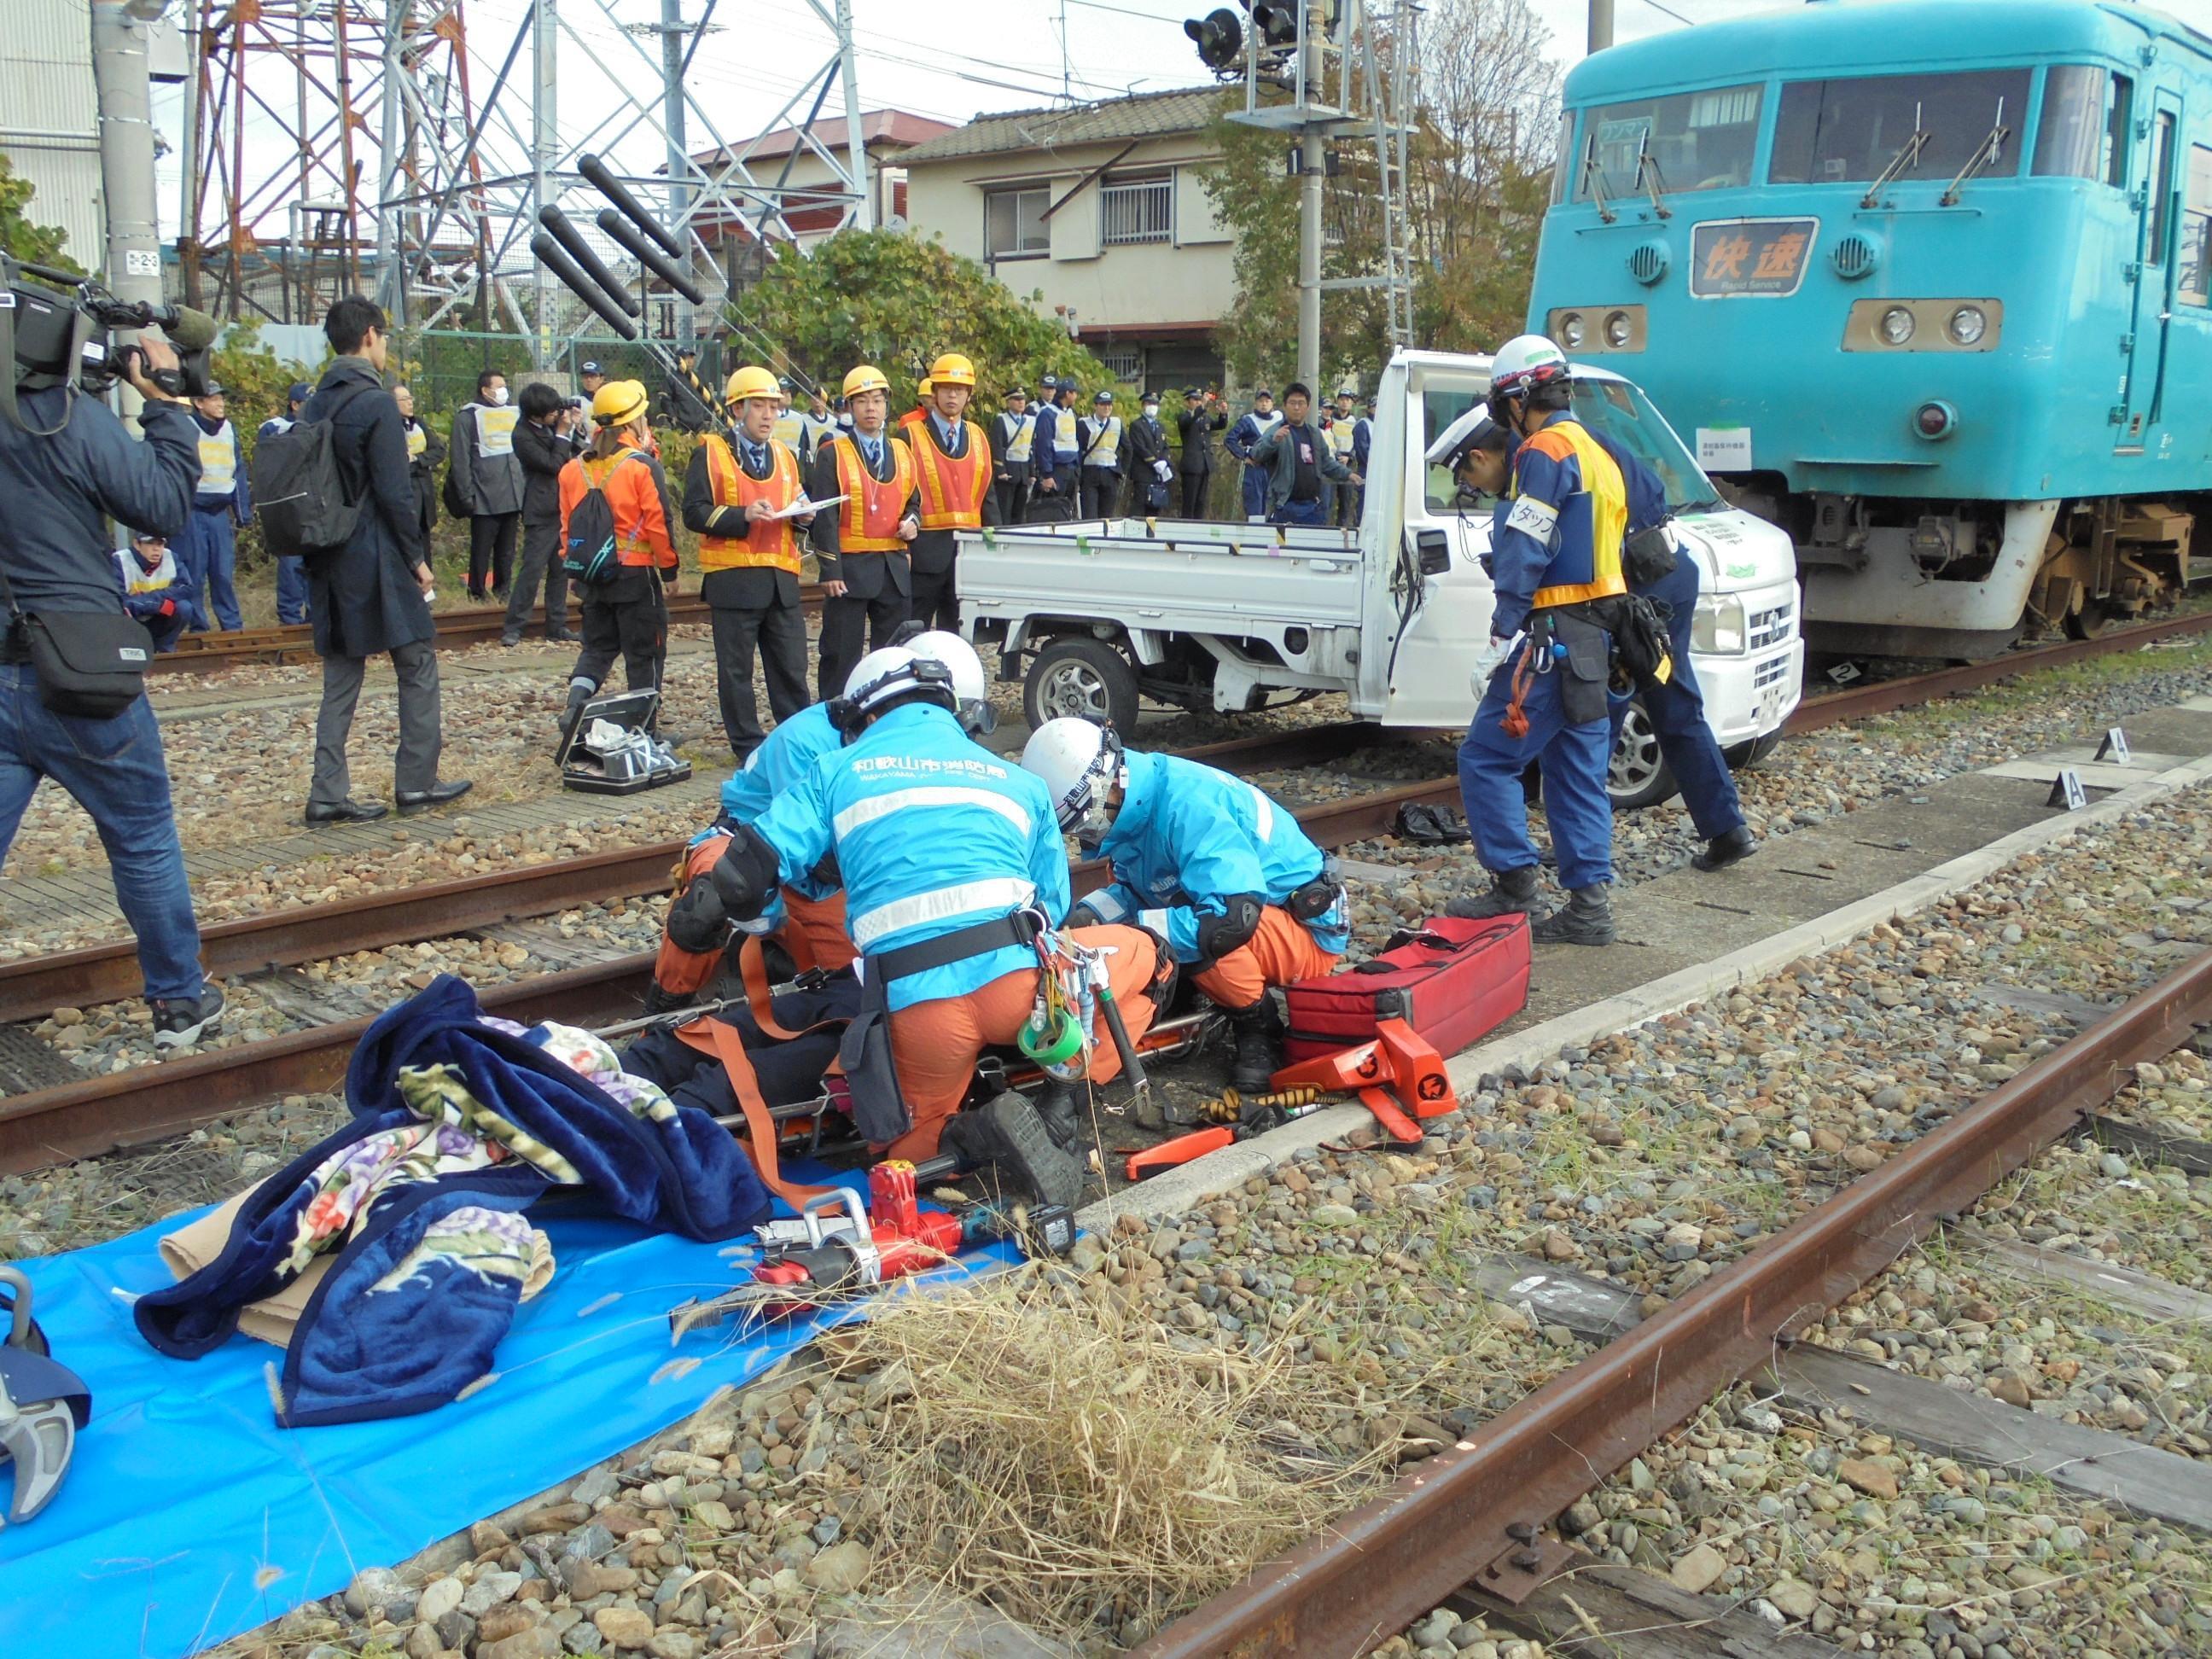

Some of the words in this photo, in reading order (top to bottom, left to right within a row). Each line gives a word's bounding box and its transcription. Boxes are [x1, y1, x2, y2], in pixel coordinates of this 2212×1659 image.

[1703, 233, 1807, 280] 快速
[1721, 281, 1747, 290] Rapid
[1836, 665, 1851, 679] 2
[853, 755, 1008, 779] 和歌山市消防局
[2068, 771, 2084, 806] A
